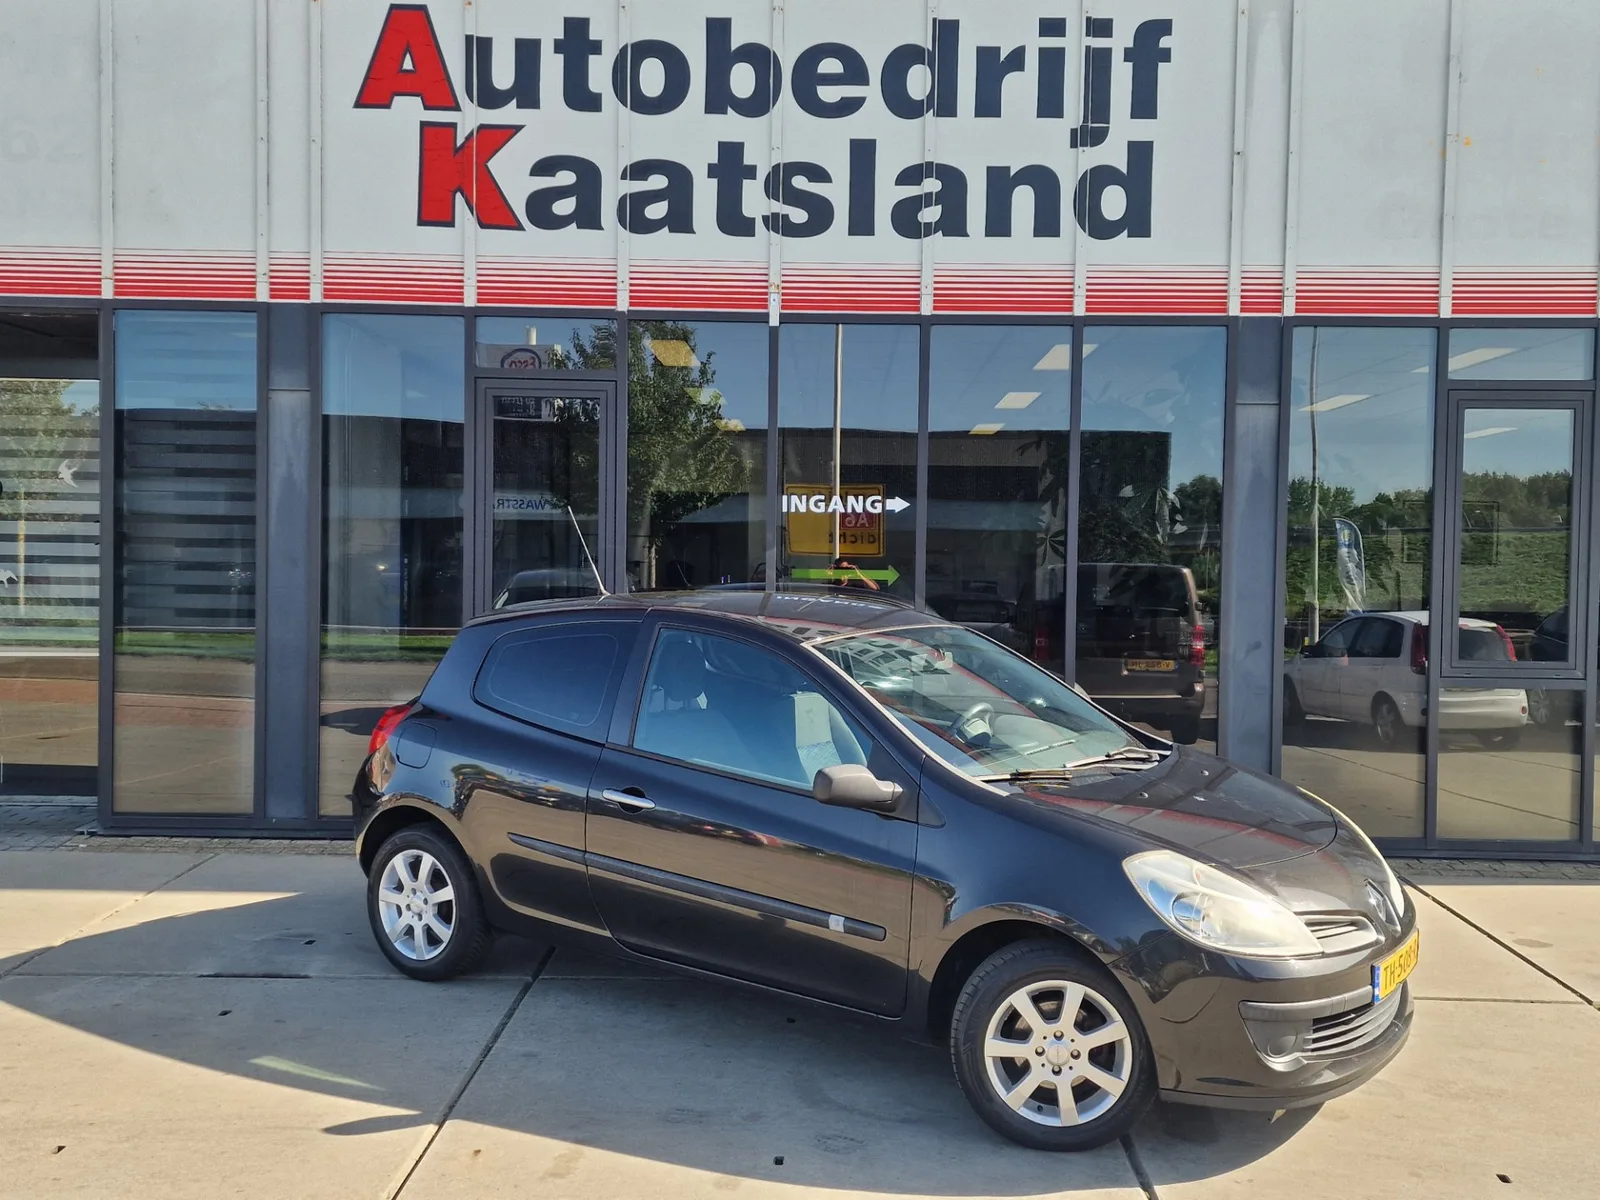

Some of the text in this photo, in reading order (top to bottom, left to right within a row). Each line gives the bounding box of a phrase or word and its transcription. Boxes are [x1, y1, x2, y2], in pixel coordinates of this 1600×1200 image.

[353, 4, 1173, 149] Autobedrijf
[417, 121, 1154, 241] Kaatsland
[781, 494, 883, 514] INGANG
